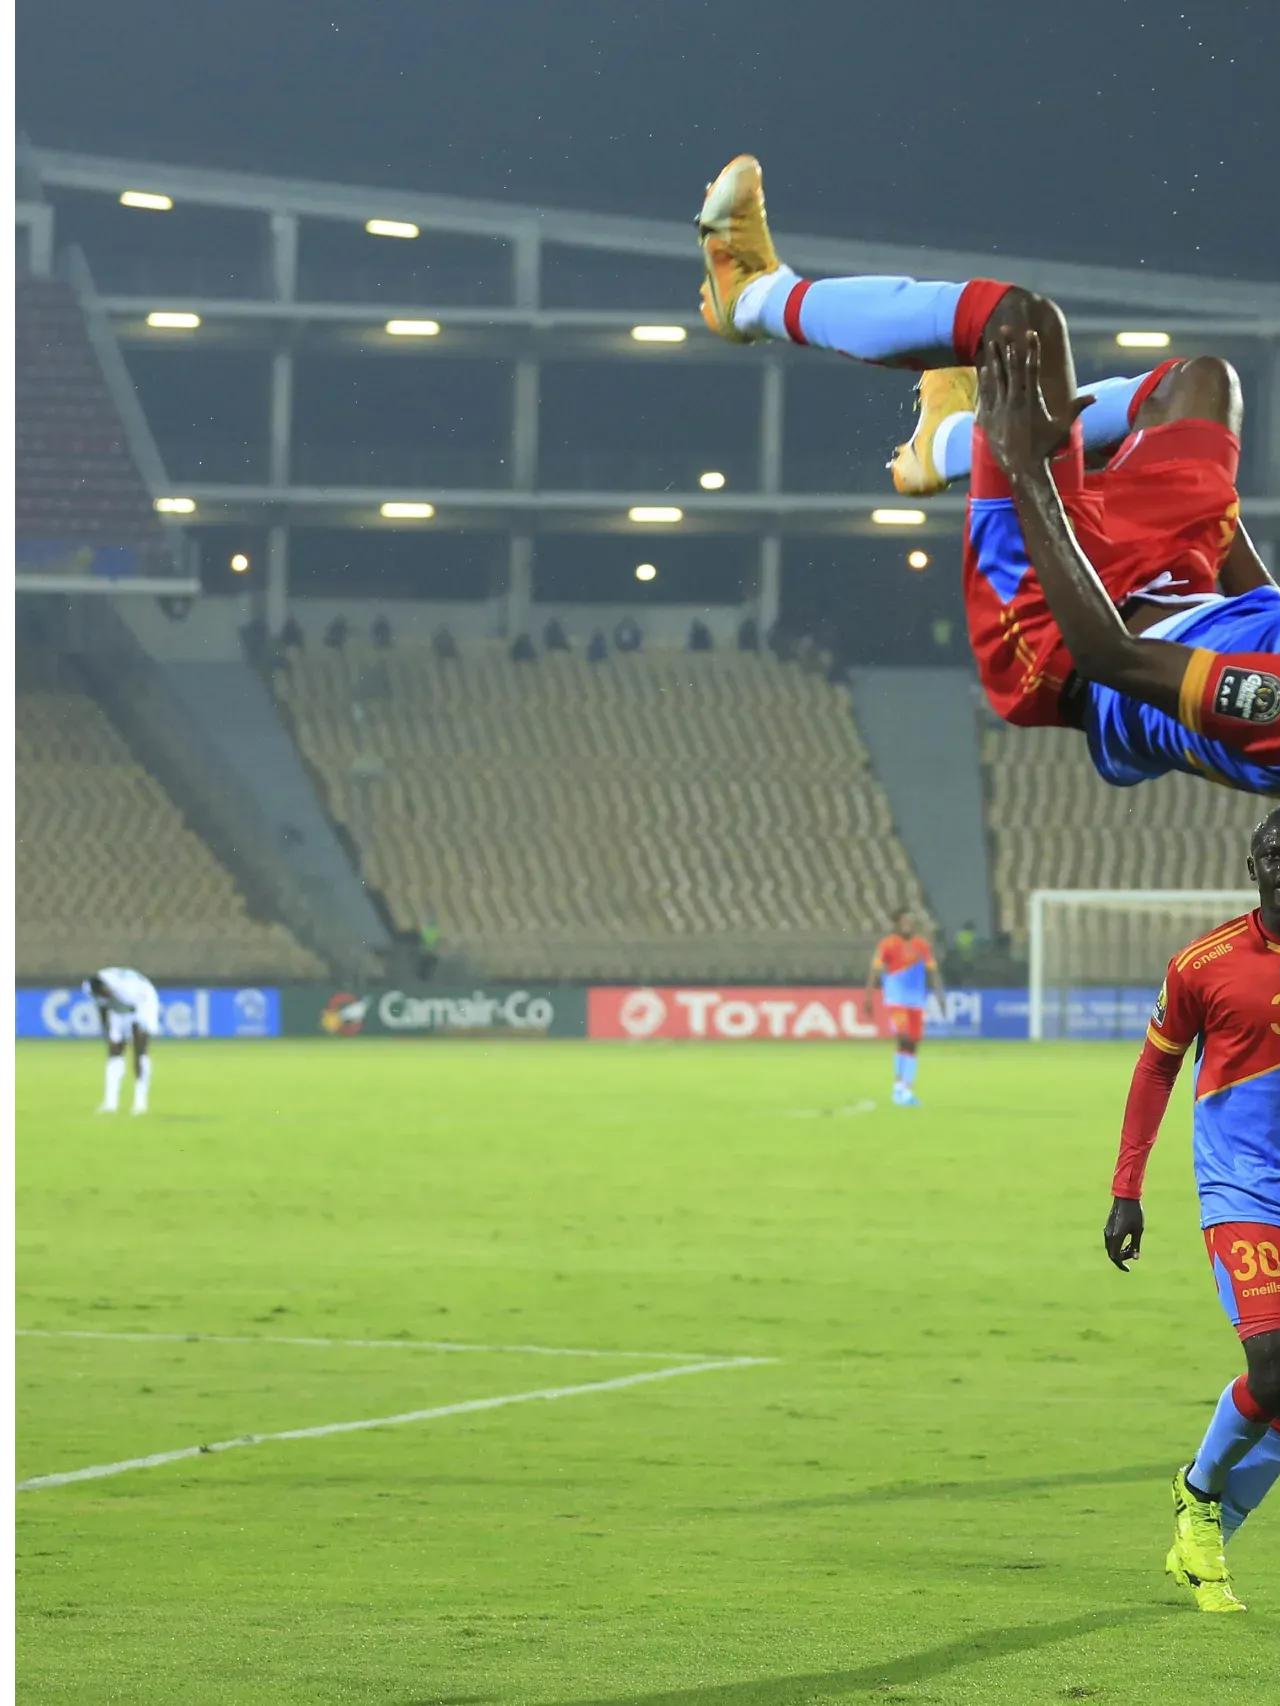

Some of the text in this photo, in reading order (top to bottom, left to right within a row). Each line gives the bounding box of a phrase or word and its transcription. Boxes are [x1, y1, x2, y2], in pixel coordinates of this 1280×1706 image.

[41, 988, 211, 1036] Cael
[377, 989, 555, 1029] Camair-Co
[674, 990, 879, 1037] TOTAL
